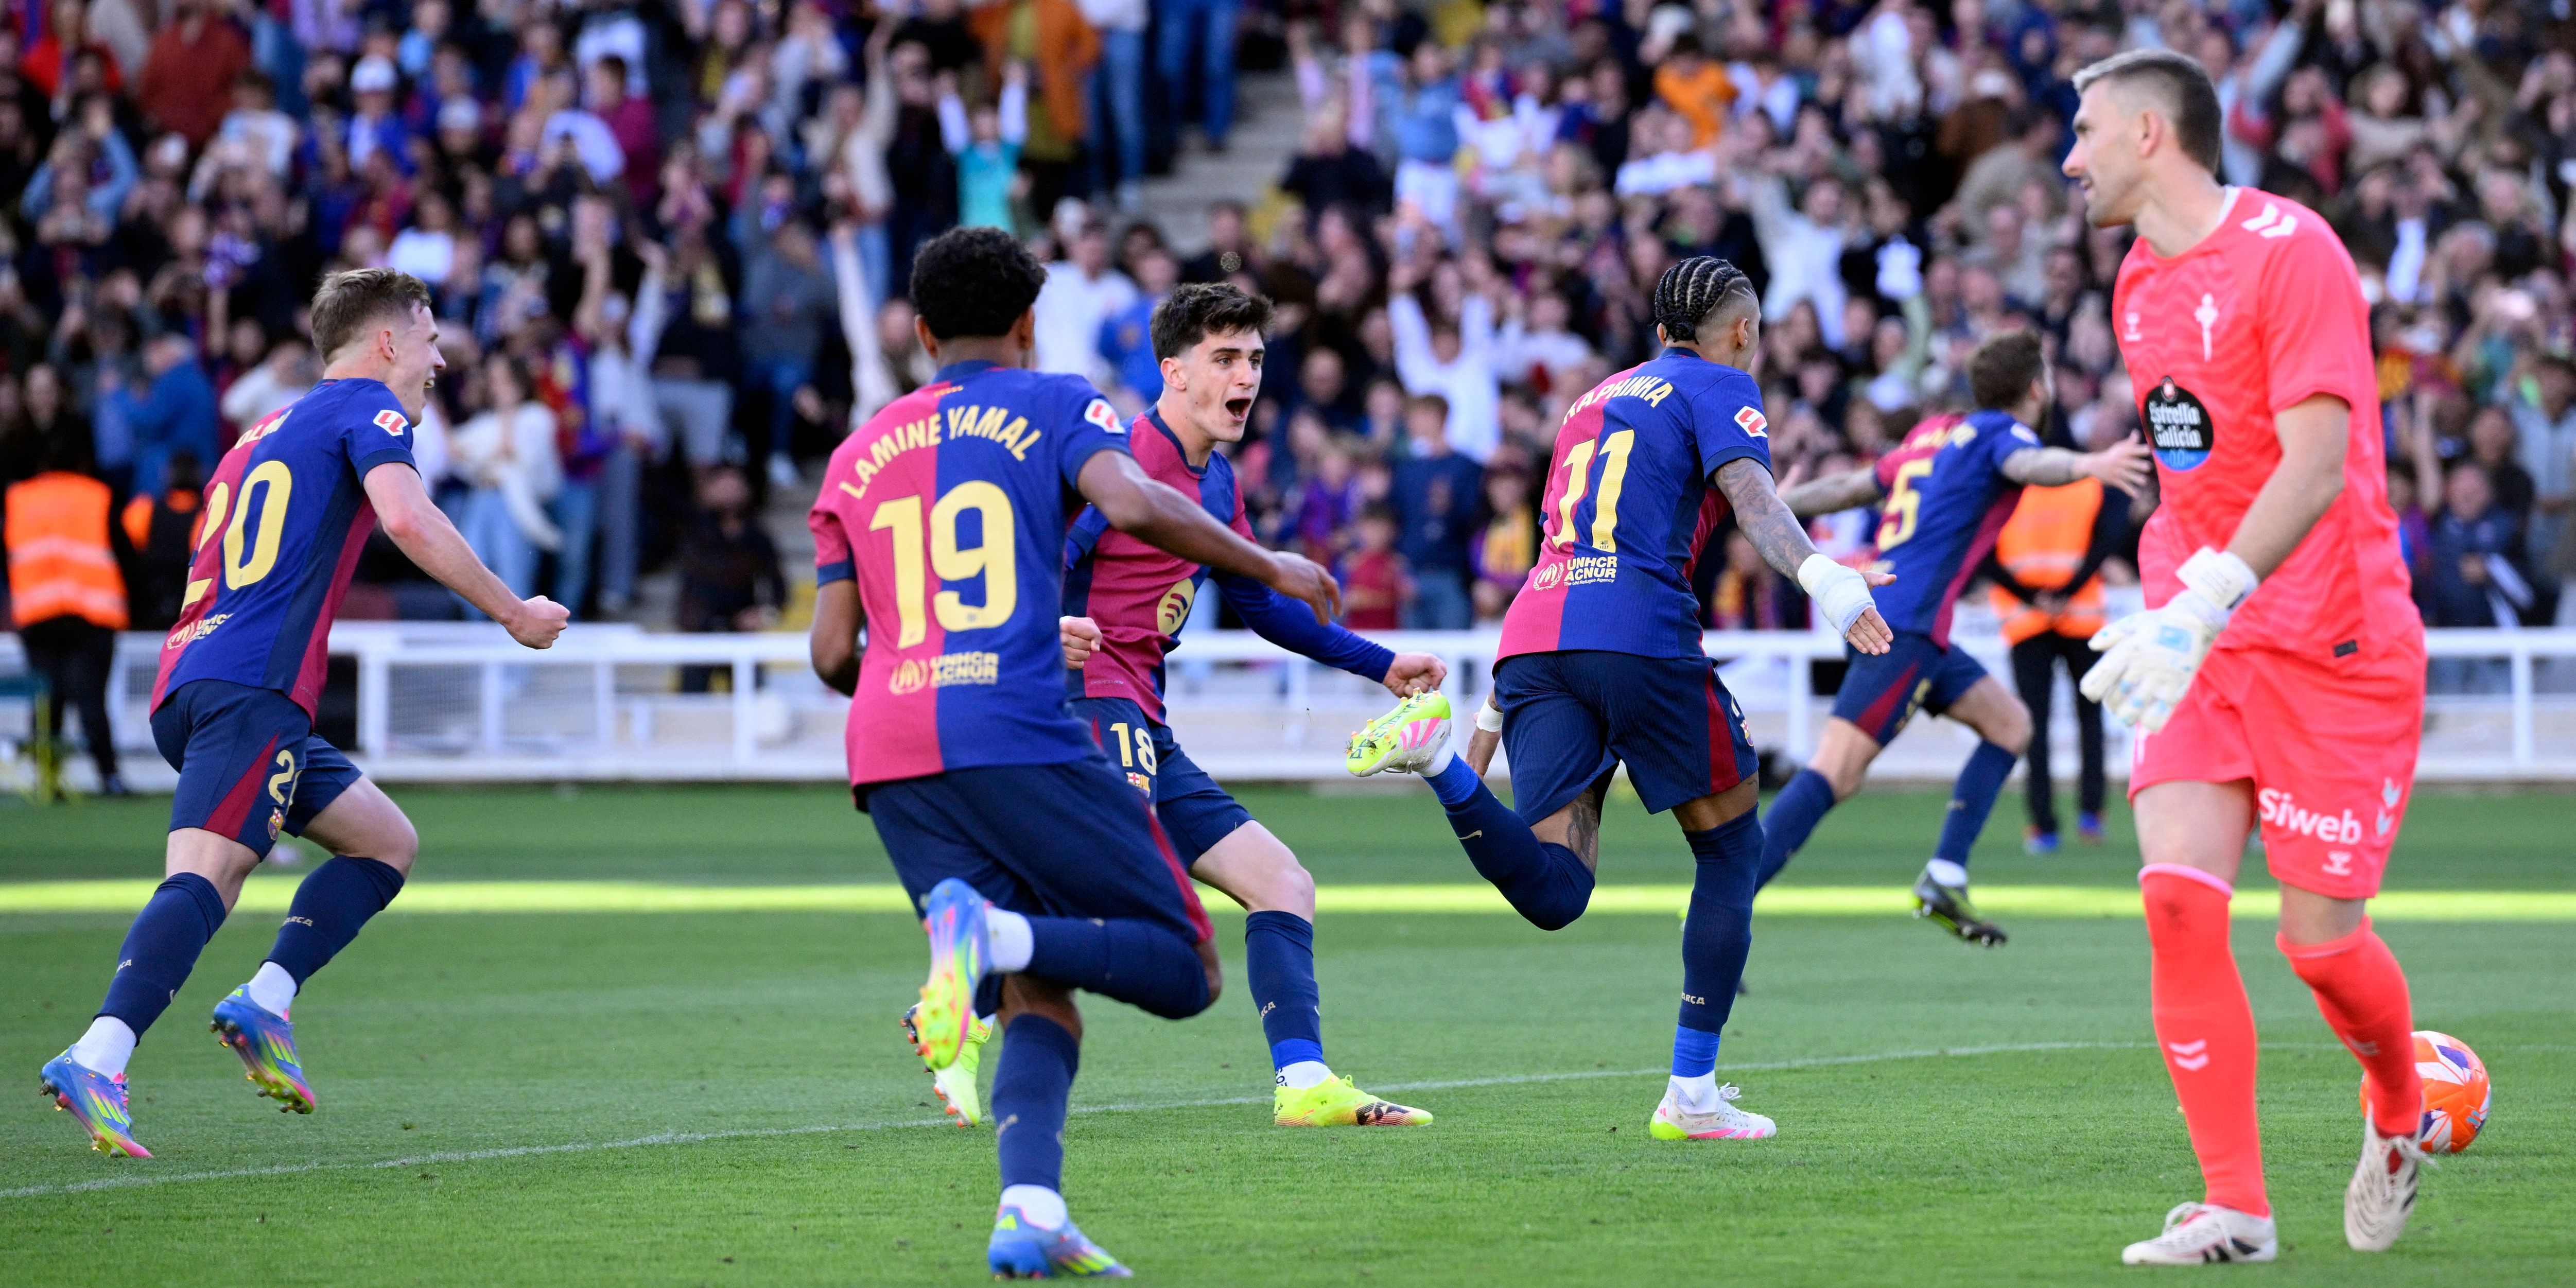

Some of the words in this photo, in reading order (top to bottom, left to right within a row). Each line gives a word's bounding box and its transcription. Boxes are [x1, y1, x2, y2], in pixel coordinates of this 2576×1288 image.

[839, 412, 942, 500] LAMINE
[947, 405, 1041, 462] YAMAL
[2154, 424, 2203, 448] Galicia
[1552, 429, 1634, 553] 11
[1877, 457, 1934, 552] 5
[868, 480, 1017, 650] 19
[1563, 567, 1617, 582] ACNUR
[1567, 556, 1617, 571] UNHCR
[1109, 723, 1157, 775] 18
[2258, 788, 2362, 845] Siweb
